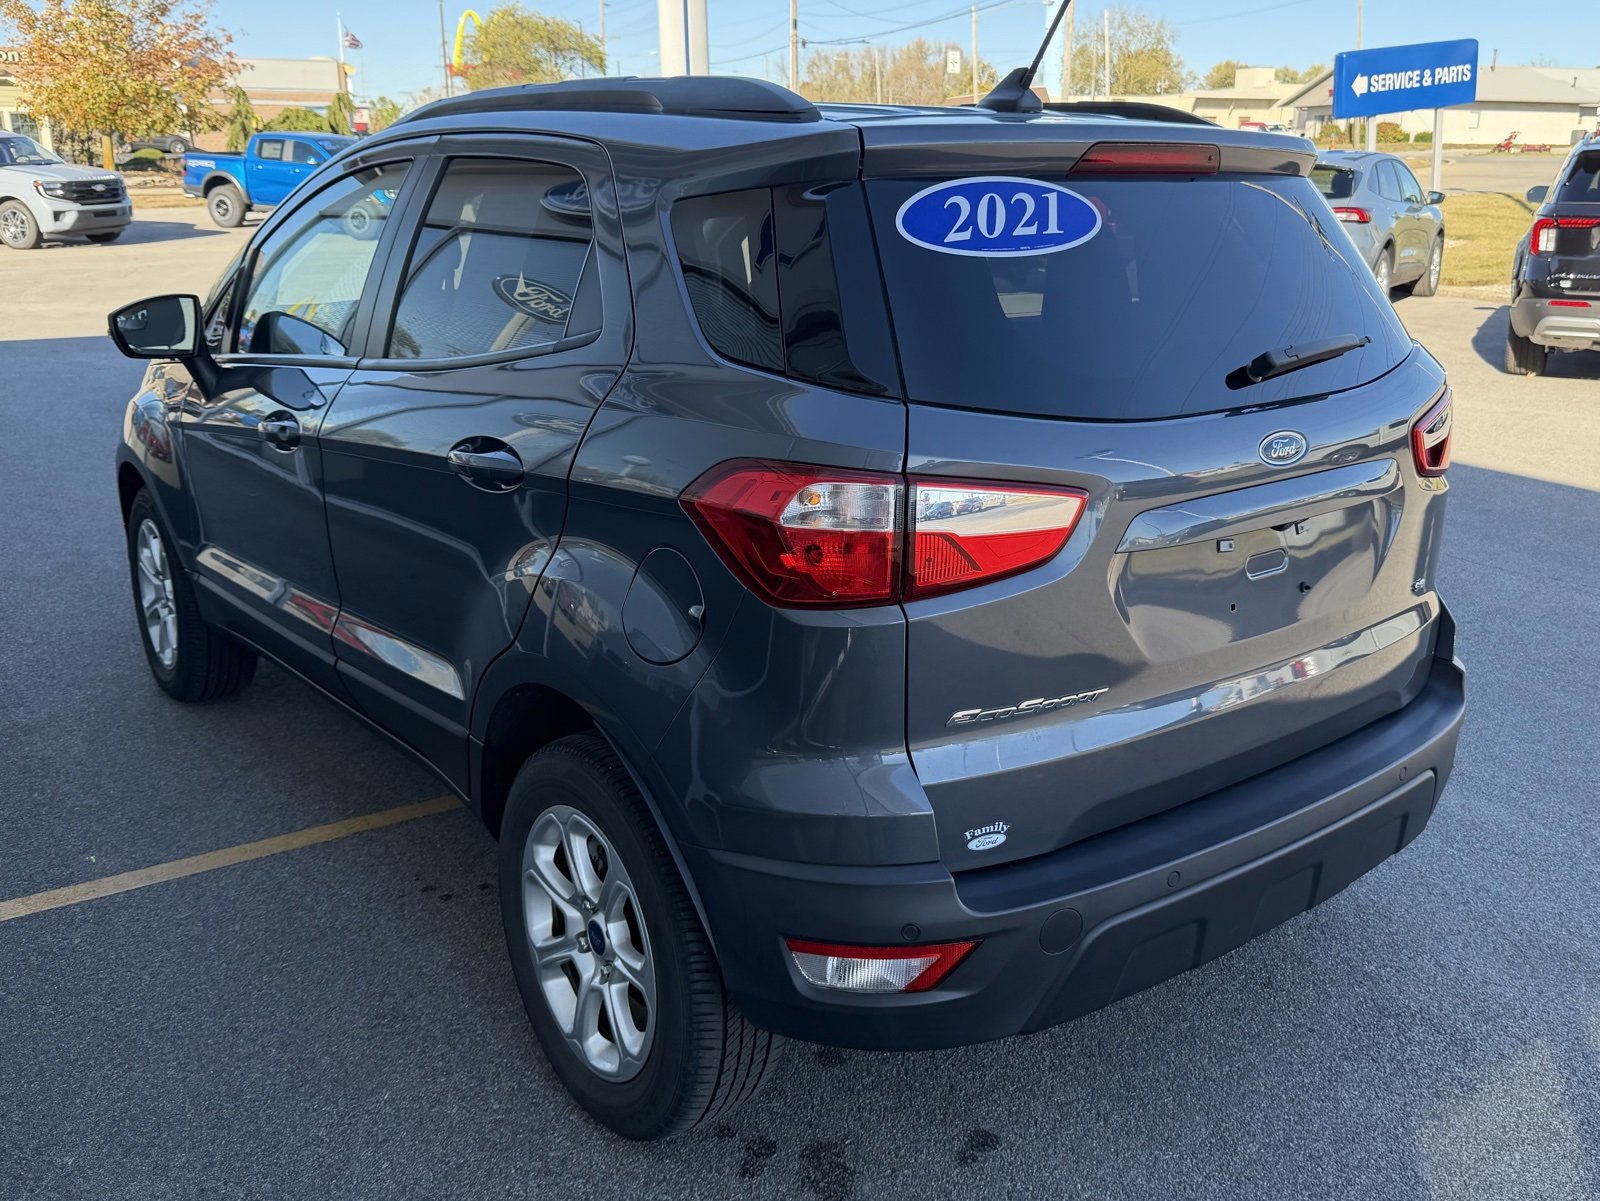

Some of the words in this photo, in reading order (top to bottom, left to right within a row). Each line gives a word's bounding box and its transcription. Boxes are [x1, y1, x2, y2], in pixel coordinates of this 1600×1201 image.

[1369, 71, 1420, 93] SERVICE
[1422, 68, 1433, 87] &
[1434, 63, 1472, 85] PARTS
[943, 191, 1065, 243] 2021
[513, 285, 570, 319] Ford
[1271, 438, 1297, 458] Ford
[963, 821, 1010, 841] Family
[975, 835, 999, 849] Ford
